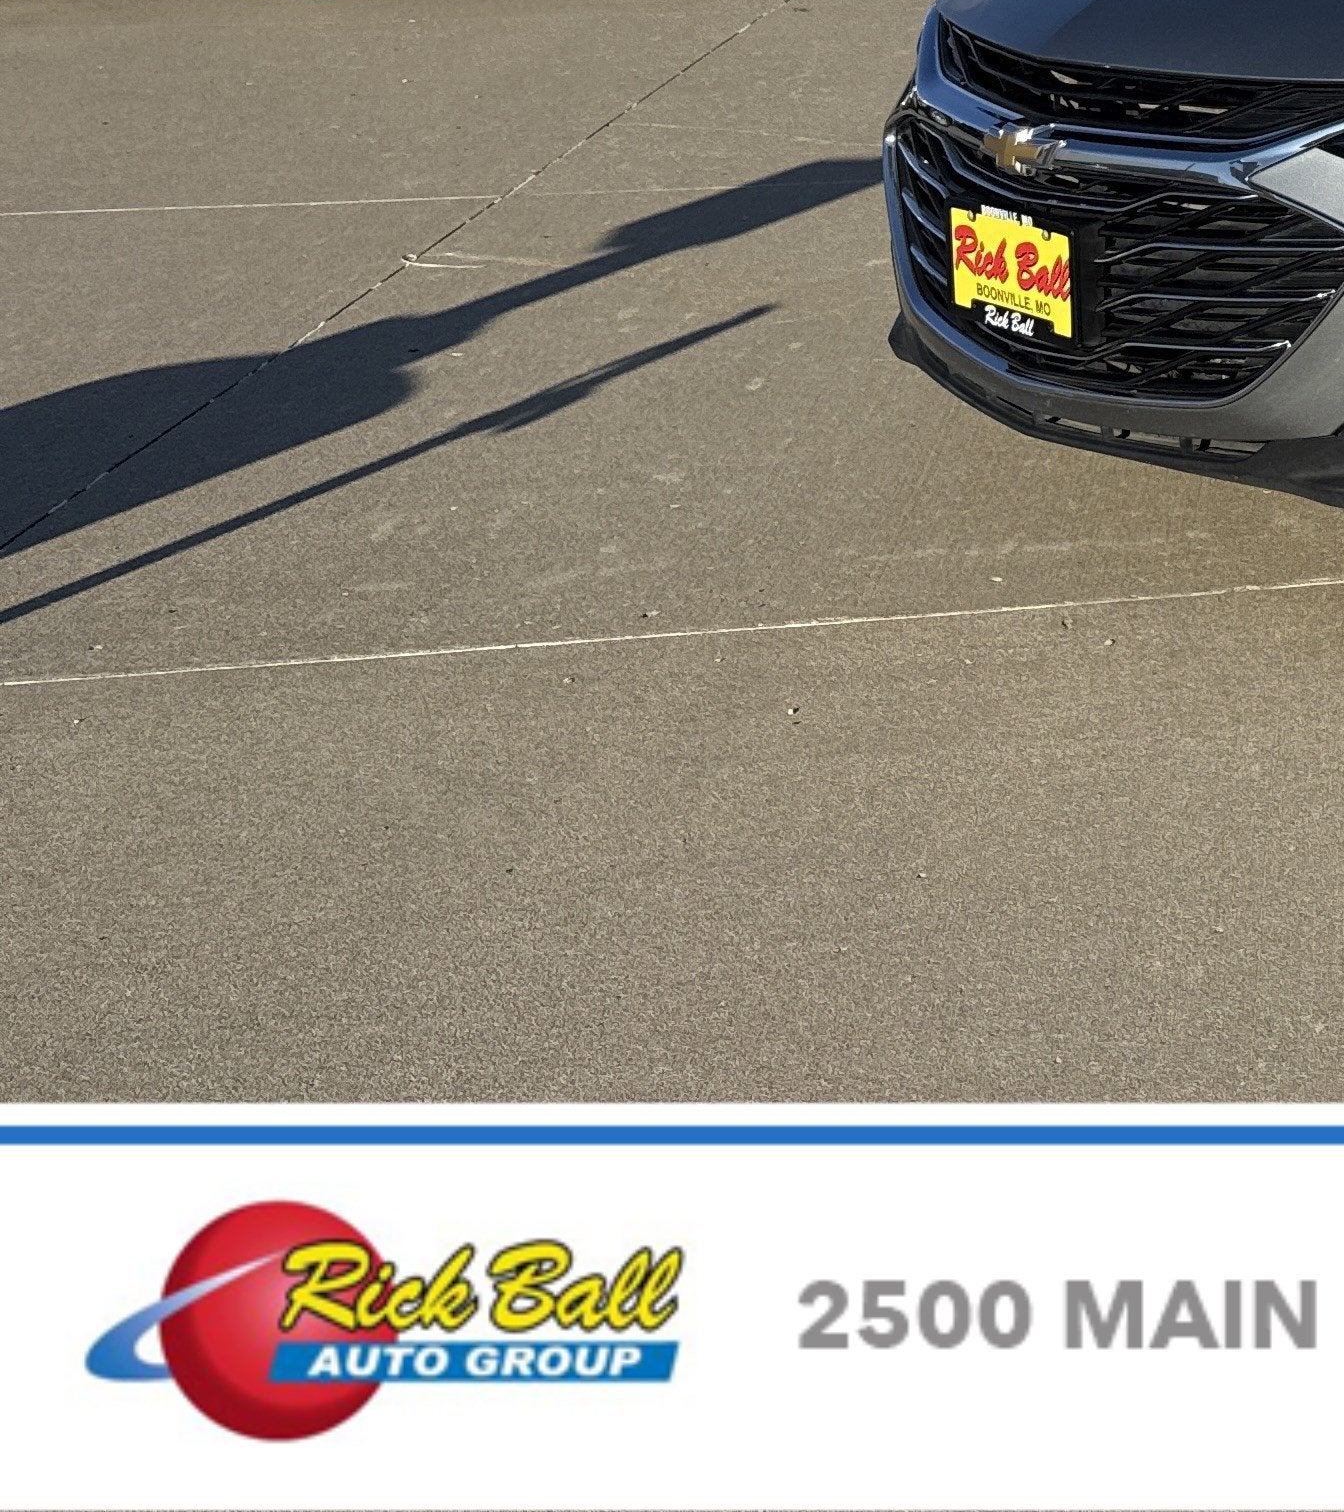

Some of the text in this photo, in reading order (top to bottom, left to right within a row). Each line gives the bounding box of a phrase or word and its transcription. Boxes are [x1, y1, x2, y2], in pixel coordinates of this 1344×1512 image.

[954, 225, 1071, 302] Rick Ball
[976, 282, 1051, 317] BOONVILLE, MO
[984, 304, 1035, 337] Rick Ball
